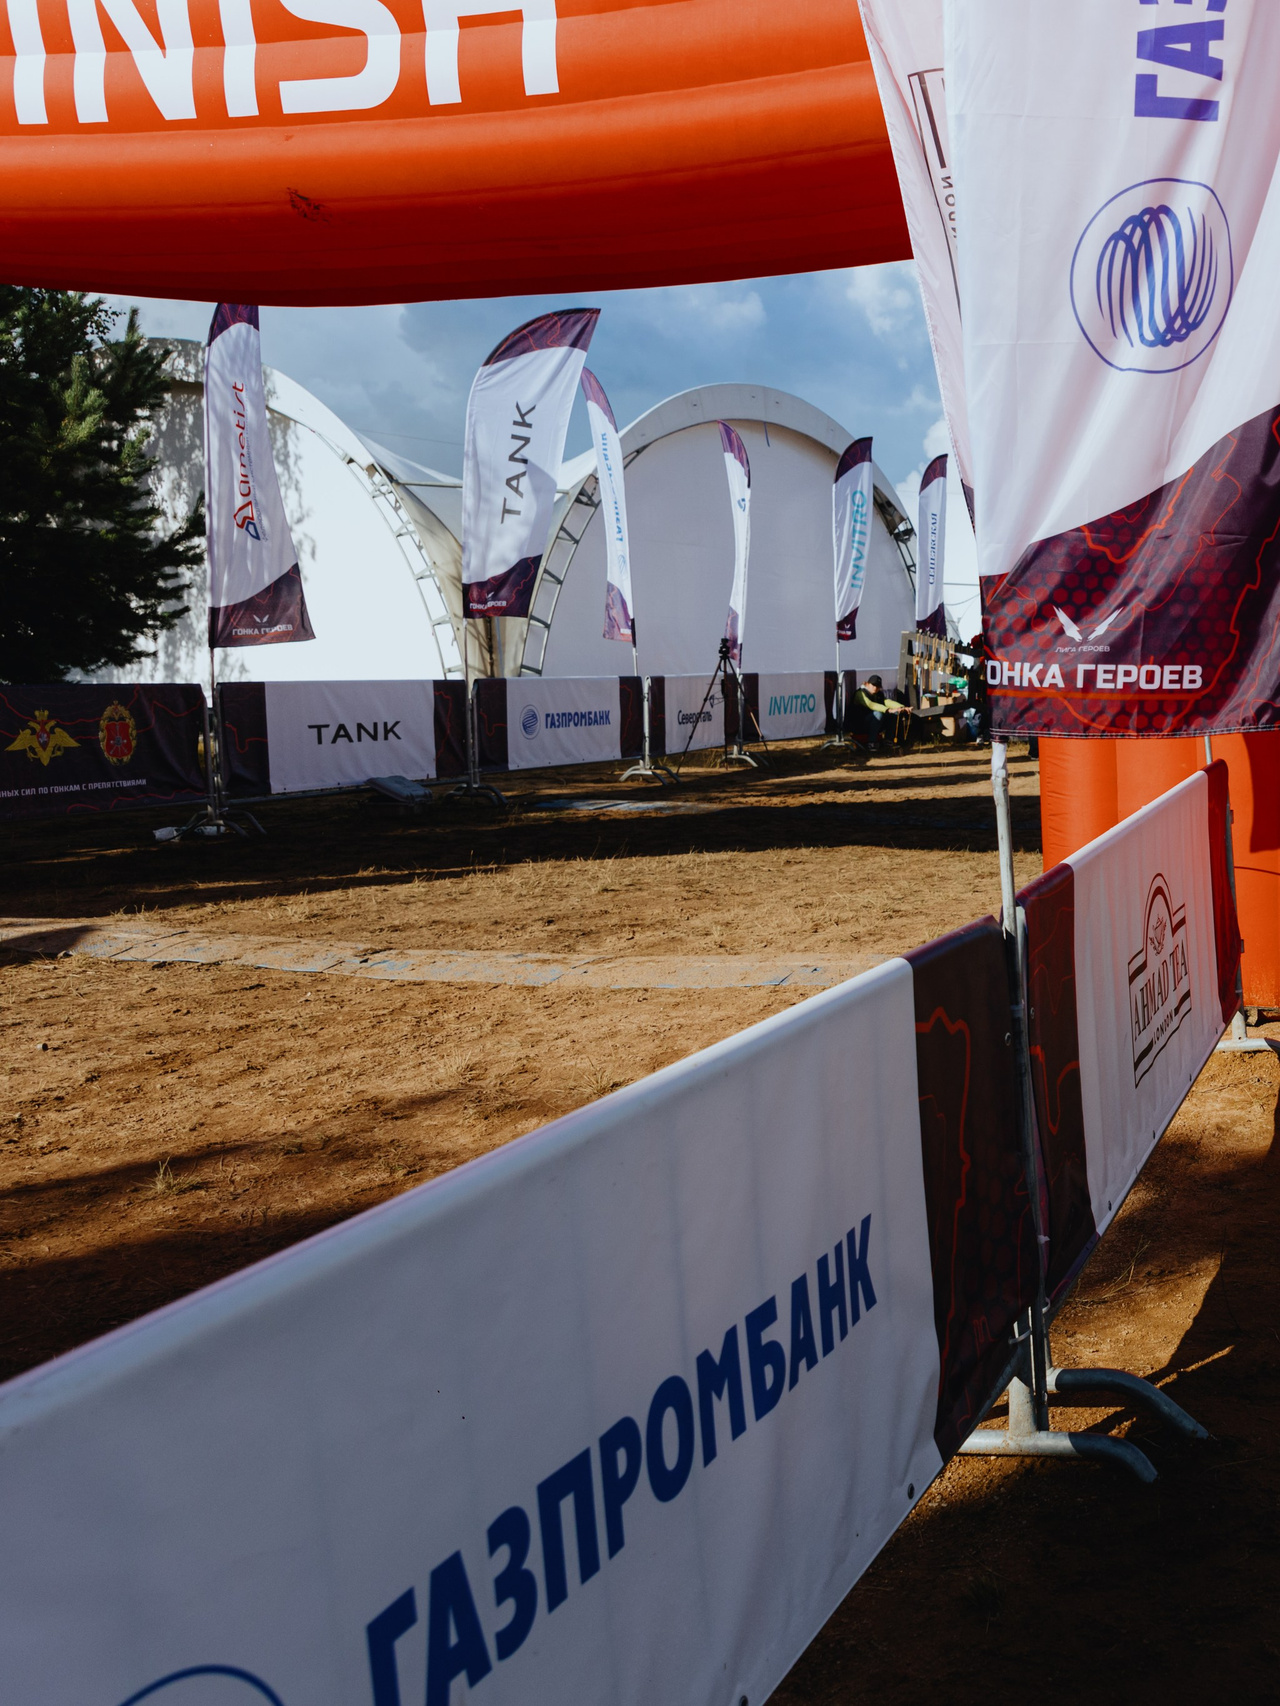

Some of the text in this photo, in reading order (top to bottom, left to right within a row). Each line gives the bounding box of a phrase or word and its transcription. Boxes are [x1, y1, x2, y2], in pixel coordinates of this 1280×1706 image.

[1134, 0, 1229, 122] ГА
[232, 380, 251, 499] ametist
[500, 400, 536, 525] TANK
[850, 489, 868, 590] INVITRO
[487, 600, 507, 608] ЕРОЕВ
[232, 624, 293, 636] ГОНКА ГЕРОЕВ
[1055, 645, 1111, 653] ЛИГА ГЕРОЕВ
[985, 659, 1203, 690] ОНКА ГЕРОЕВ
[544, 710, 611, 729] ГАЗПРОМБАНК
[768, 693, 816, 716] INVITRO
[307, 720, 402, 745] TANK
[0, 789, 19, 798] НЫХ
[21, 788, 36, 796] СИЛ
[50, 784, 81, 793] ГОНКАМ
[82, 783, 87, 791] С
[88, 778, 147, 790] ПРЕПЯТСТВИЯМИ
[1134, 939, 1188, 1042] AHMAD TEA
[1153, 1008, 1174, 1045] LONDON
[366, 1213, 877, 1706] ГАЗПРОМБАНК
